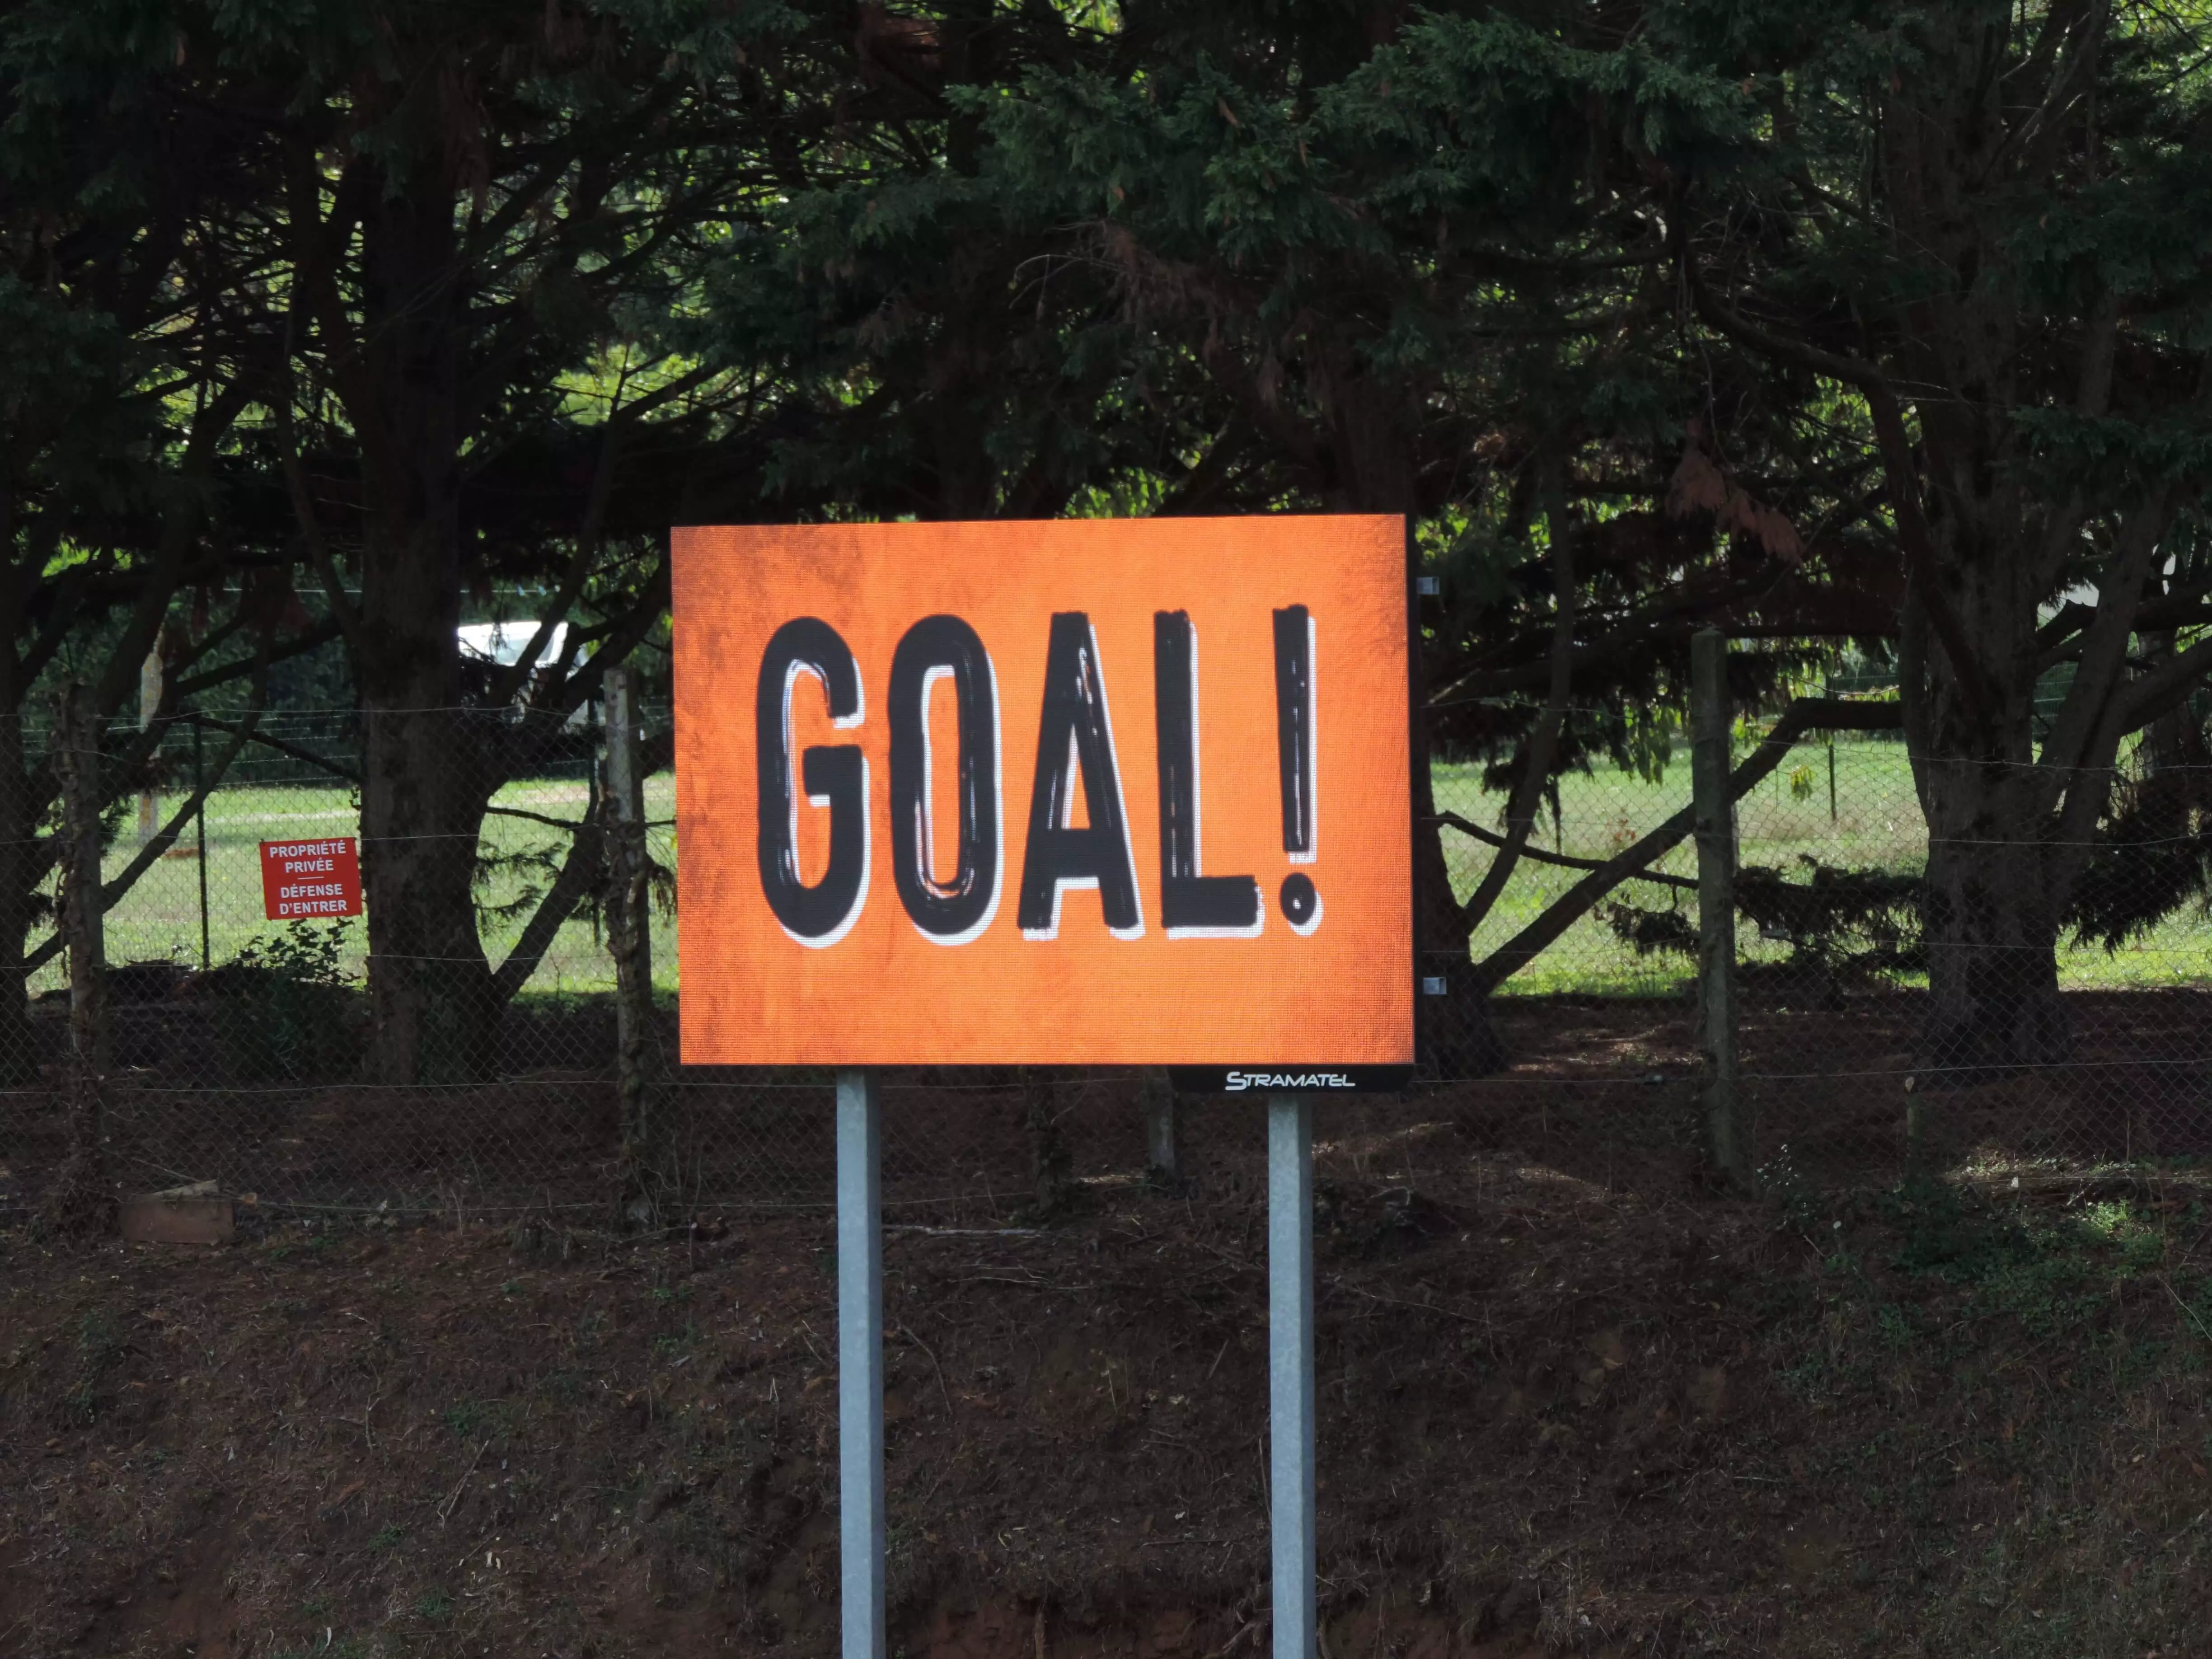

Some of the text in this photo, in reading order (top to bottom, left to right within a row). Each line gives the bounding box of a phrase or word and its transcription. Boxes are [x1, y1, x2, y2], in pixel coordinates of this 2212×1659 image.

[756, 604, 1322, 948] GOAL!
[269, 840, 346, 858] PROPRIÉTÉ
[285, 858, 334, 873] PRIVÉE
[280, 884, 343, 898] DÉFENSE
[279, 900, 347, 914] D'ENTRER
[1225, 1072, 1355, 1091] STRAMATEL
